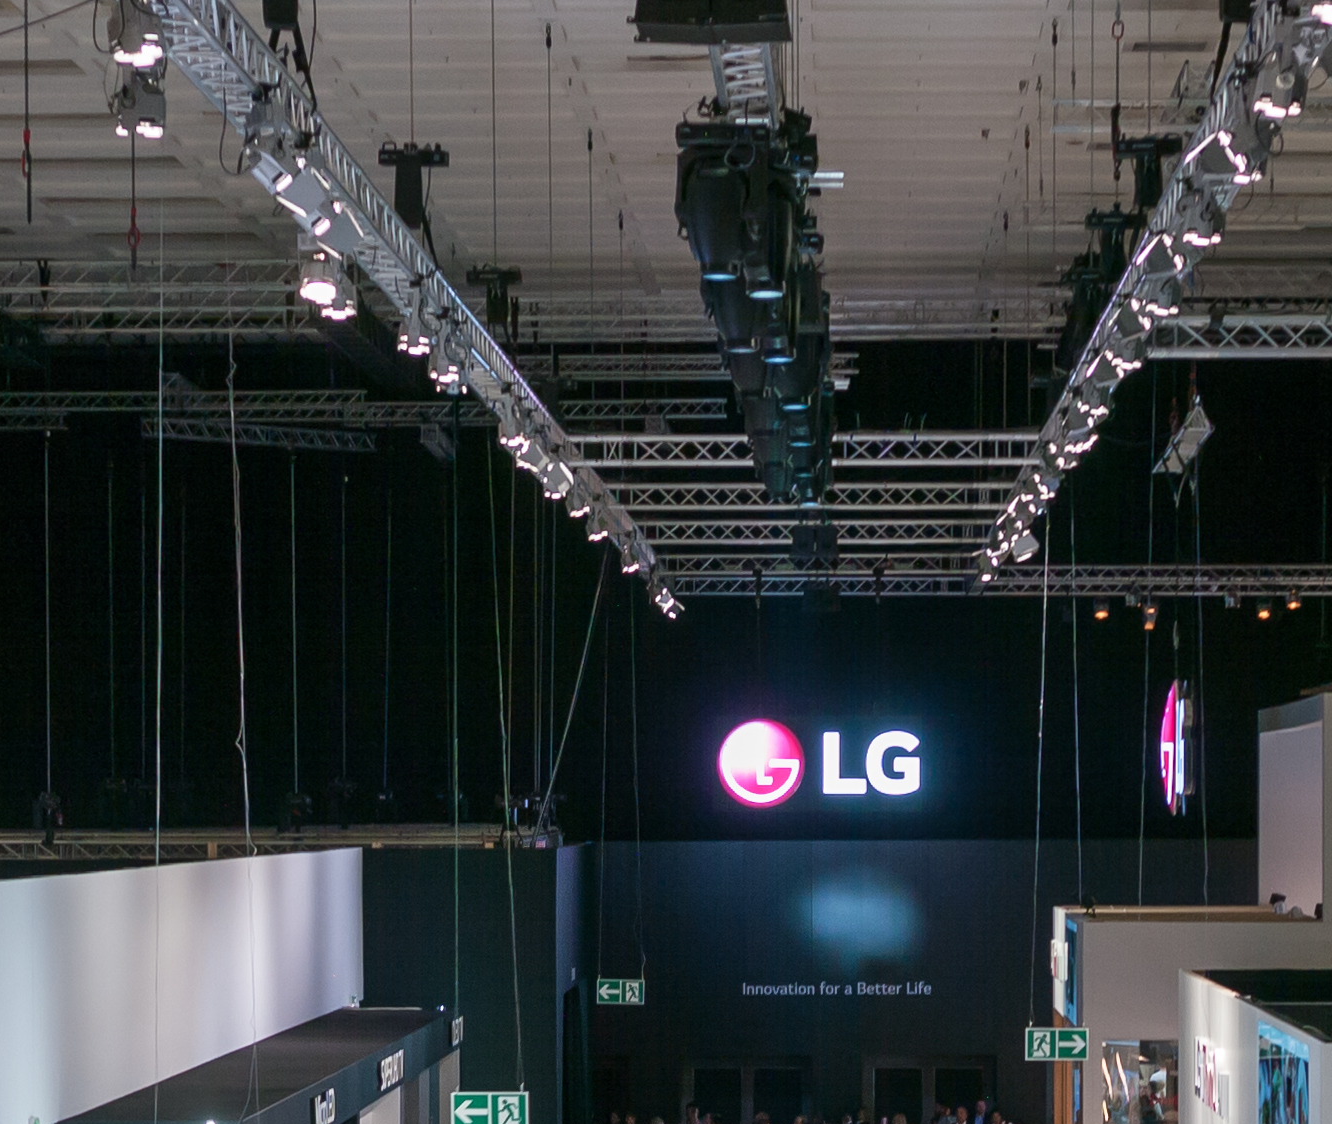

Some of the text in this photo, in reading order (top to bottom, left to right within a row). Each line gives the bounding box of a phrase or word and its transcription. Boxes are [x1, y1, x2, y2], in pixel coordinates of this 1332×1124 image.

[823, 730, 921, 795] LG
[742, 981, 932, 996] Innovation for a Better Life
